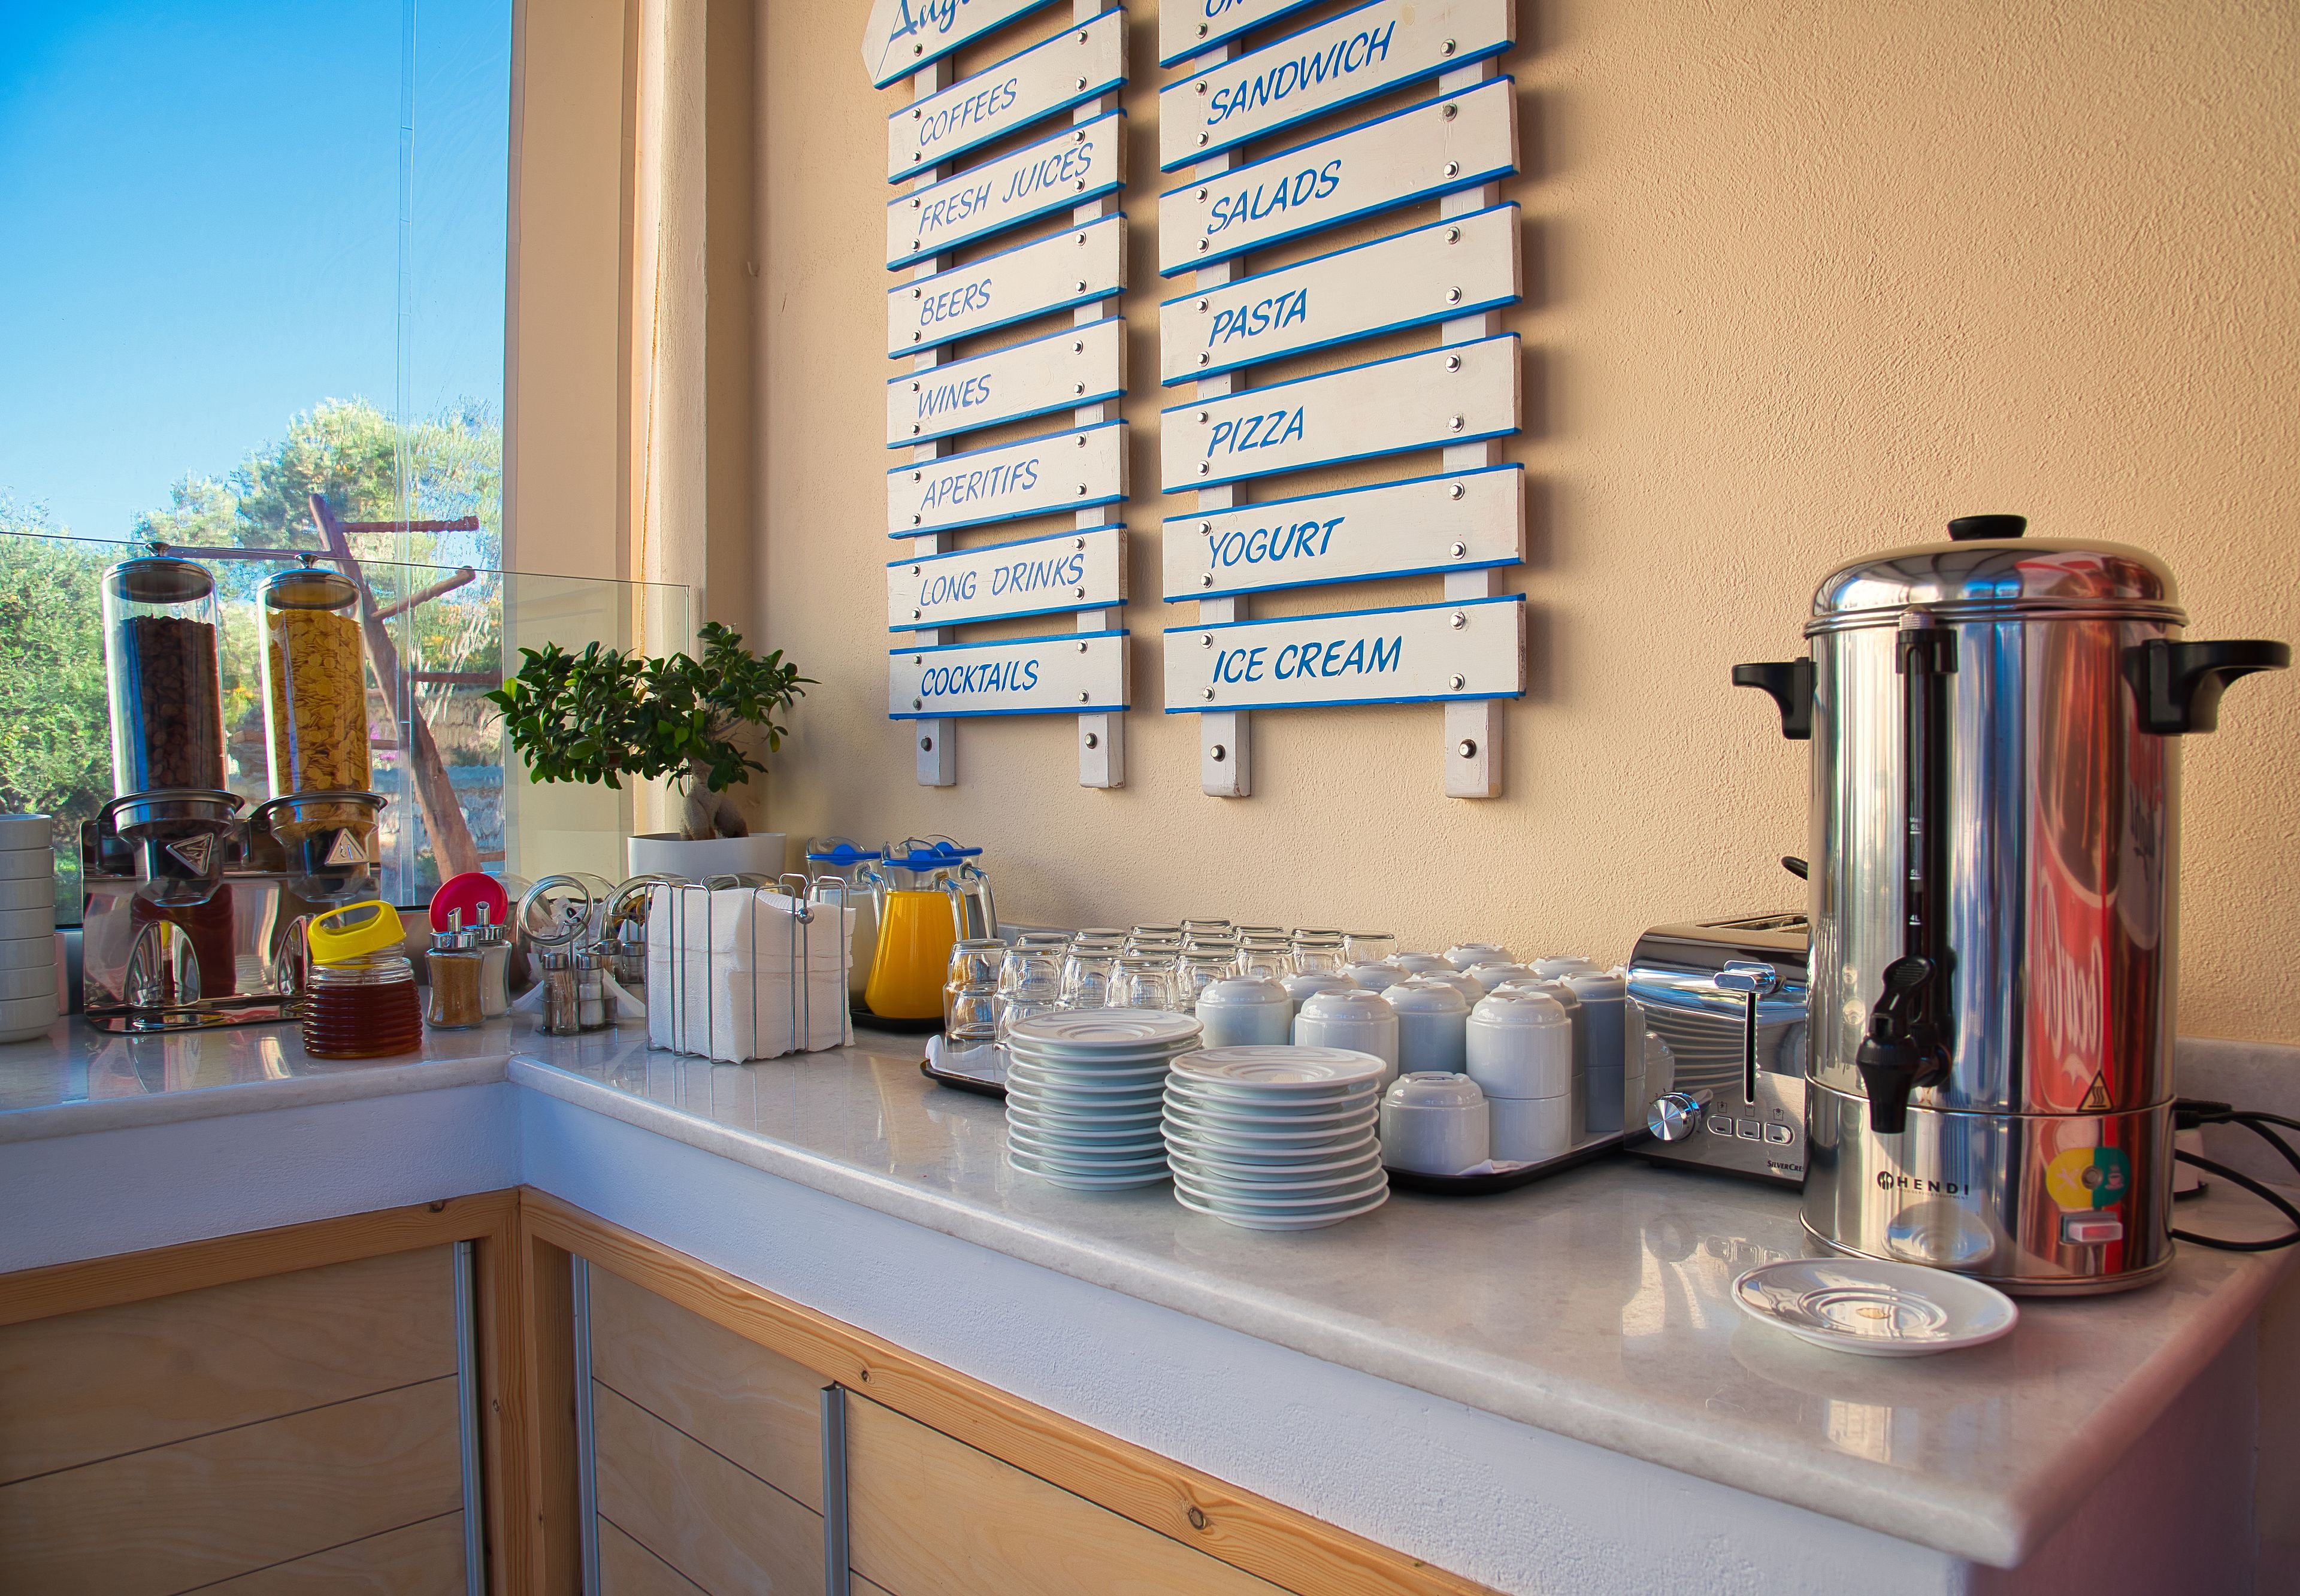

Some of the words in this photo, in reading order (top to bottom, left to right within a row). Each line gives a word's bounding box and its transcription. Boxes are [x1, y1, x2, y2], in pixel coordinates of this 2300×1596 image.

[1207, 19, 1396, 125] SANDWICH
[919, 77, 1017, 146] COFFEES
[918, 181, 992, 235] FRESH
[1002, 142, 1094, 203] JUICES
[1207, 159, 1342, 235] SALADS
[920, 278, 992, 326] BEERS
[1209, 287, 1308, 347] PASTA
[918, 373, 991, 417] WINES
[1207, 406, 1304, 458] PIZZA
[921, 459, 1039, 507] APERITIFS
[1209, 517, 1345, 569] YOGURT
[920, 571, 977, 607] LONG
[992, 553, 1084, 596] DRINKS
[920, 658, 1039, 698] COCKTAILS
[1212, 646, 1268, 684] ICE
[1274, 635, 1402, 680] CREAM
[1897, 1176, 1969, 1195] HENDI
